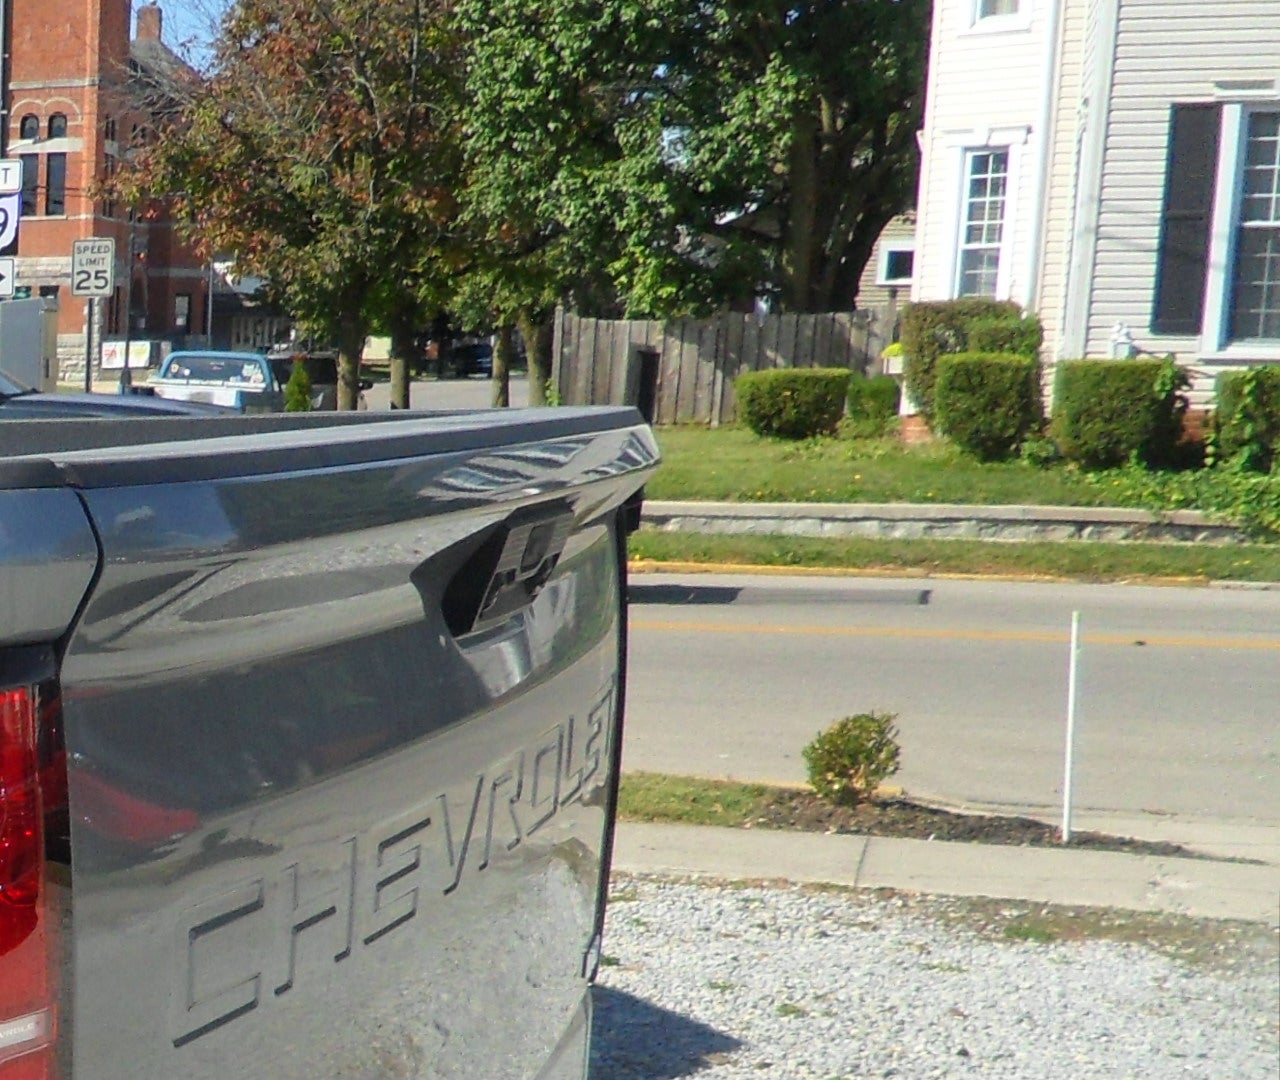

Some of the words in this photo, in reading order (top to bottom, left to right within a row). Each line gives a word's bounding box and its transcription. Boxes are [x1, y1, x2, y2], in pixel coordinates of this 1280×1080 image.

[76, 244, 111, 255] SPEED
[79, 257, 106, 267] LIMIT
[75, 270, 109, 291] 25
[172, 680, 614, 1049] CHEVROLET
